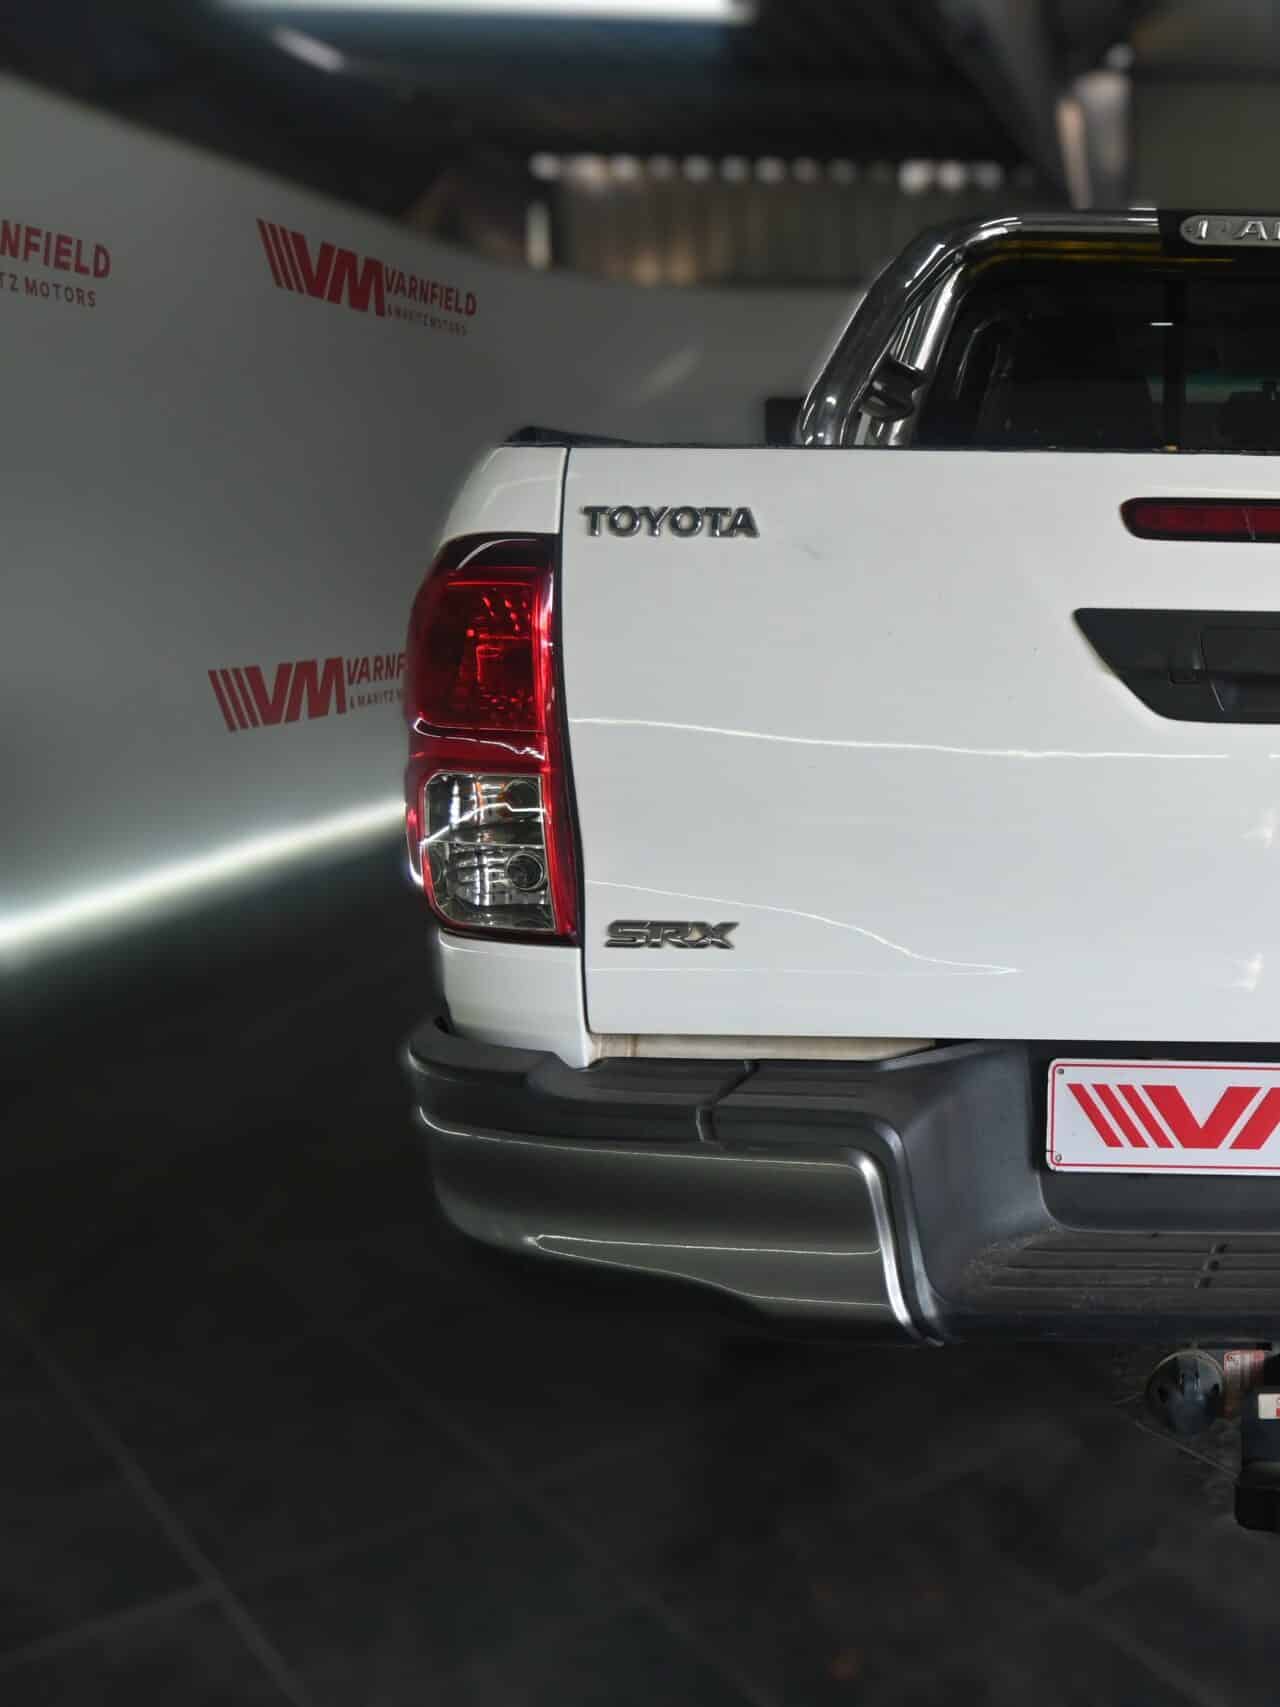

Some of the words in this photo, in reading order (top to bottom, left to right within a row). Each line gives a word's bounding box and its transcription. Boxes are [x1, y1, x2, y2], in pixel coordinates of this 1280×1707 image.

[291, 231, 385, 318] VM
[384, 264, 477, 317] VARNFIELD
[24, 276, 96, 307] MOTORS
[581, 505, 760, 538] TOYOTA
[347, 653, 409, 686] VARNF
[243, 656, 347, 726] VM
[604, 920, 739, 950] SRX
